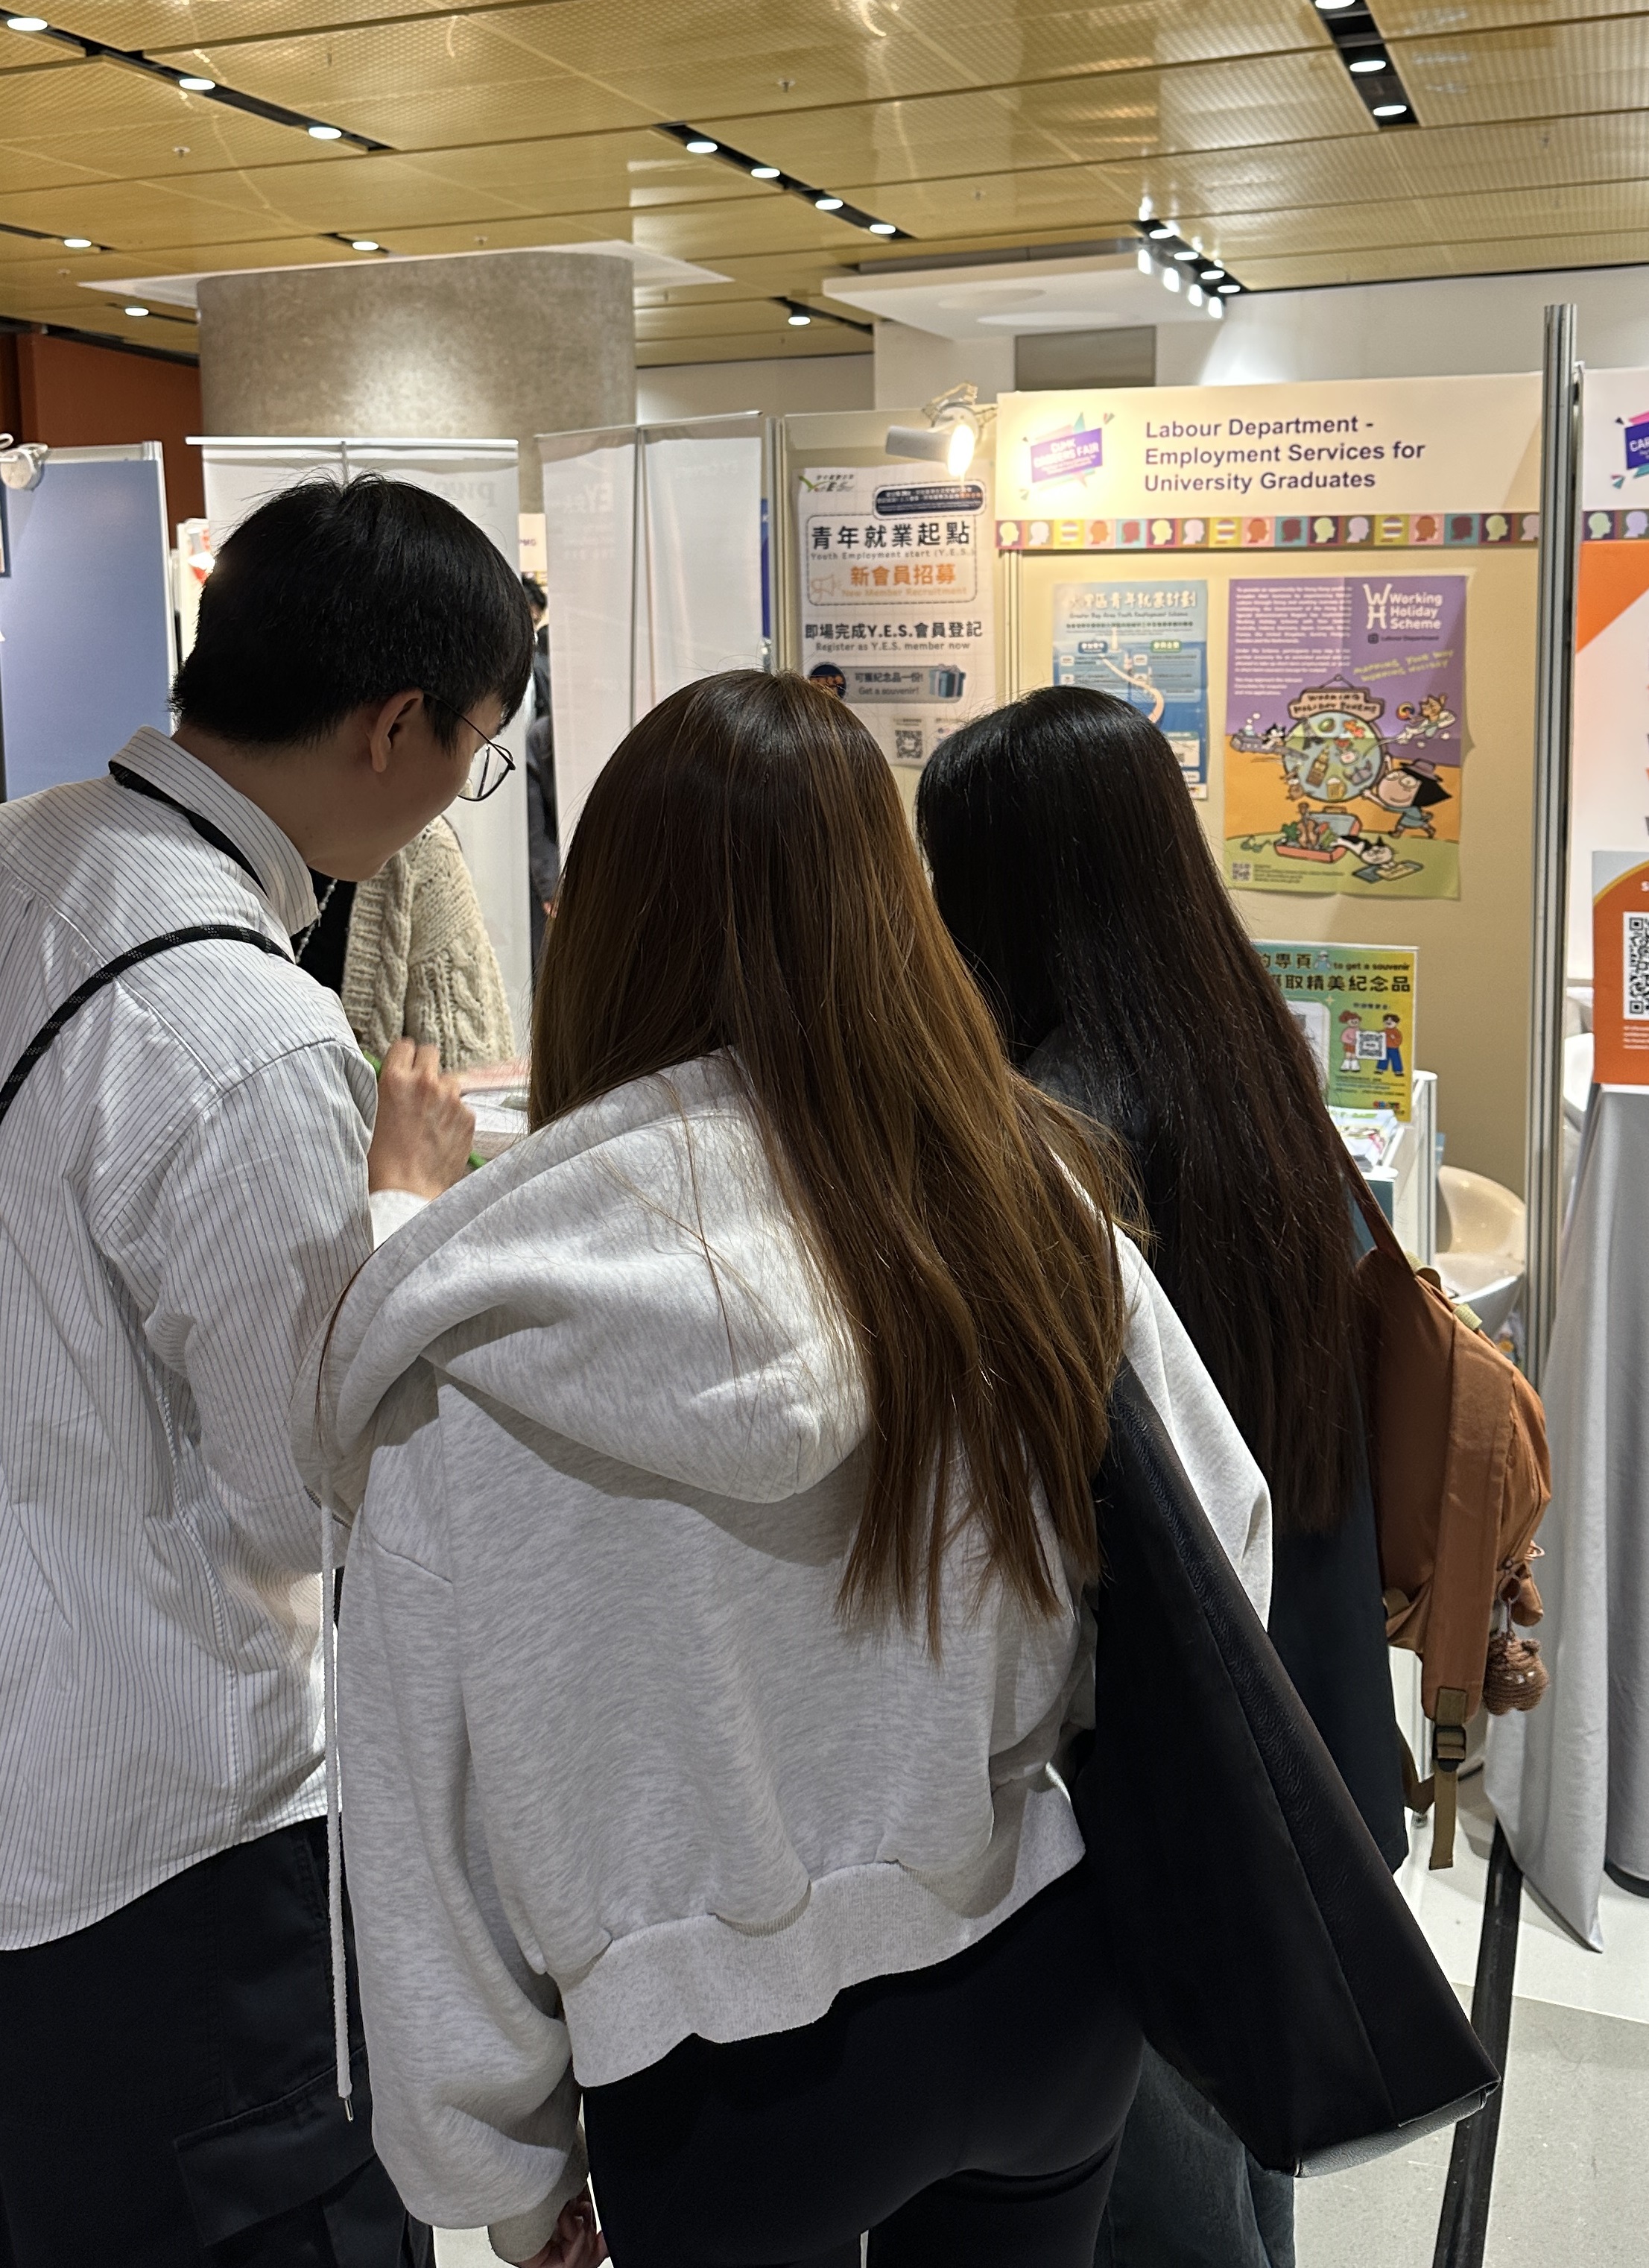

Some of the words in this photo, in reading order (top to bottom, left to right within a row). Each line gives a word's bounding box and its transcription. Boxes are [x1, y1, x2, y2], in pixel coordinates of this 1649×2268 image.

[1146, 420, 1222, 438] Labour
[1229, 415, 1359, 439] Department
[1145, 446, 1281, 469] Employment
[1288, 442, 1385, 463] Services
[1392, 440, 1425, 460] for
[1145, 473, 1253, 494] University
[1260, 470, 1376, 490] Graduates
[811, 520, 970, 550] 青年就業起點
[841, 551, 901, 560] Employment
[850, 563, 955, 587] 新會員招募
[1390, 593, 1443, 606] Working
[1390, 605, 1439, 619] Holiday
[805, 621, 983, 639] 即場完成Y.E.S.會員登記
[1390, 618, 1442, 630] Scheme
[816, 642, 855, 653] Register
[858, 643, 868, 651] as
[904, 640, 945, 651] member
[949, 642, 971, 650] now
[858, 686, 873, 695] Get
[1346, 961, 1361, 972] get
